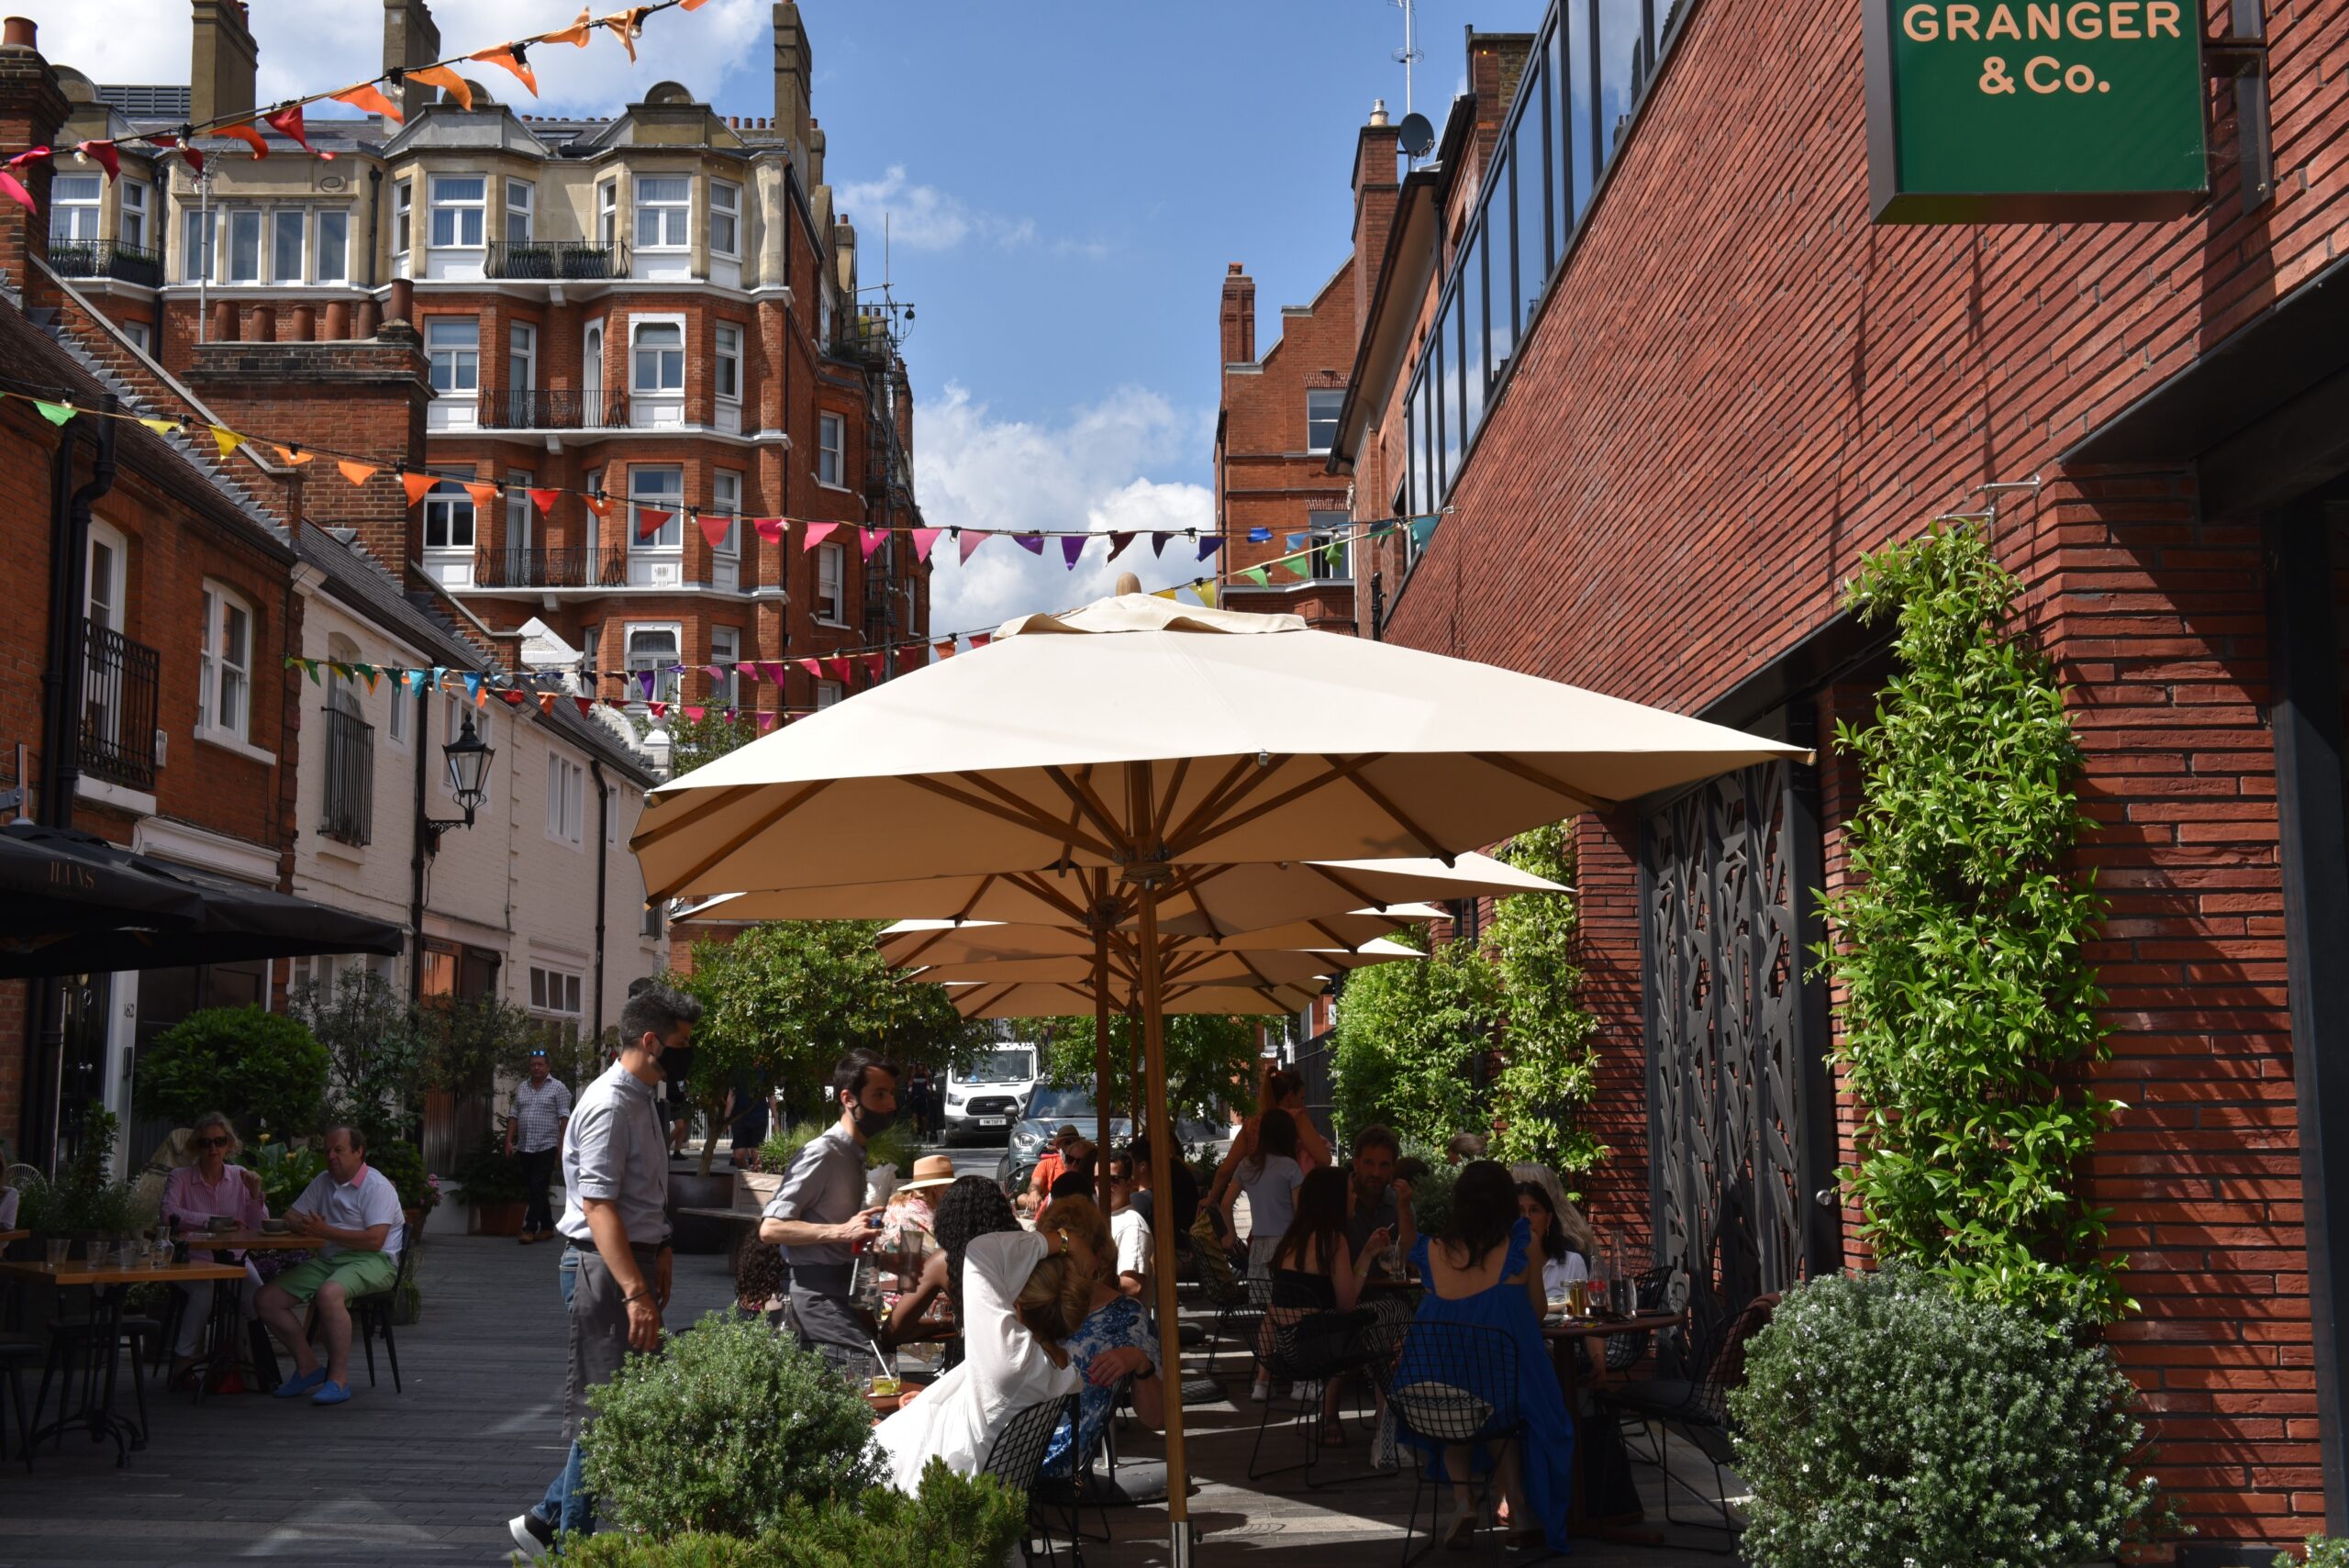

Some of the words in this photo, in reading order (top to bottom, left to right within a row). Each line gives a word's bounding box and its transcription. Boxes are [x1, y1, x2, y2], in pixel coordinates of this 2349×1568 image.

[1903, 1, 2181, 42] GRANGER
[1978, 56, 2016, 95] &
[2024, 55, 2110, 95] Co.
